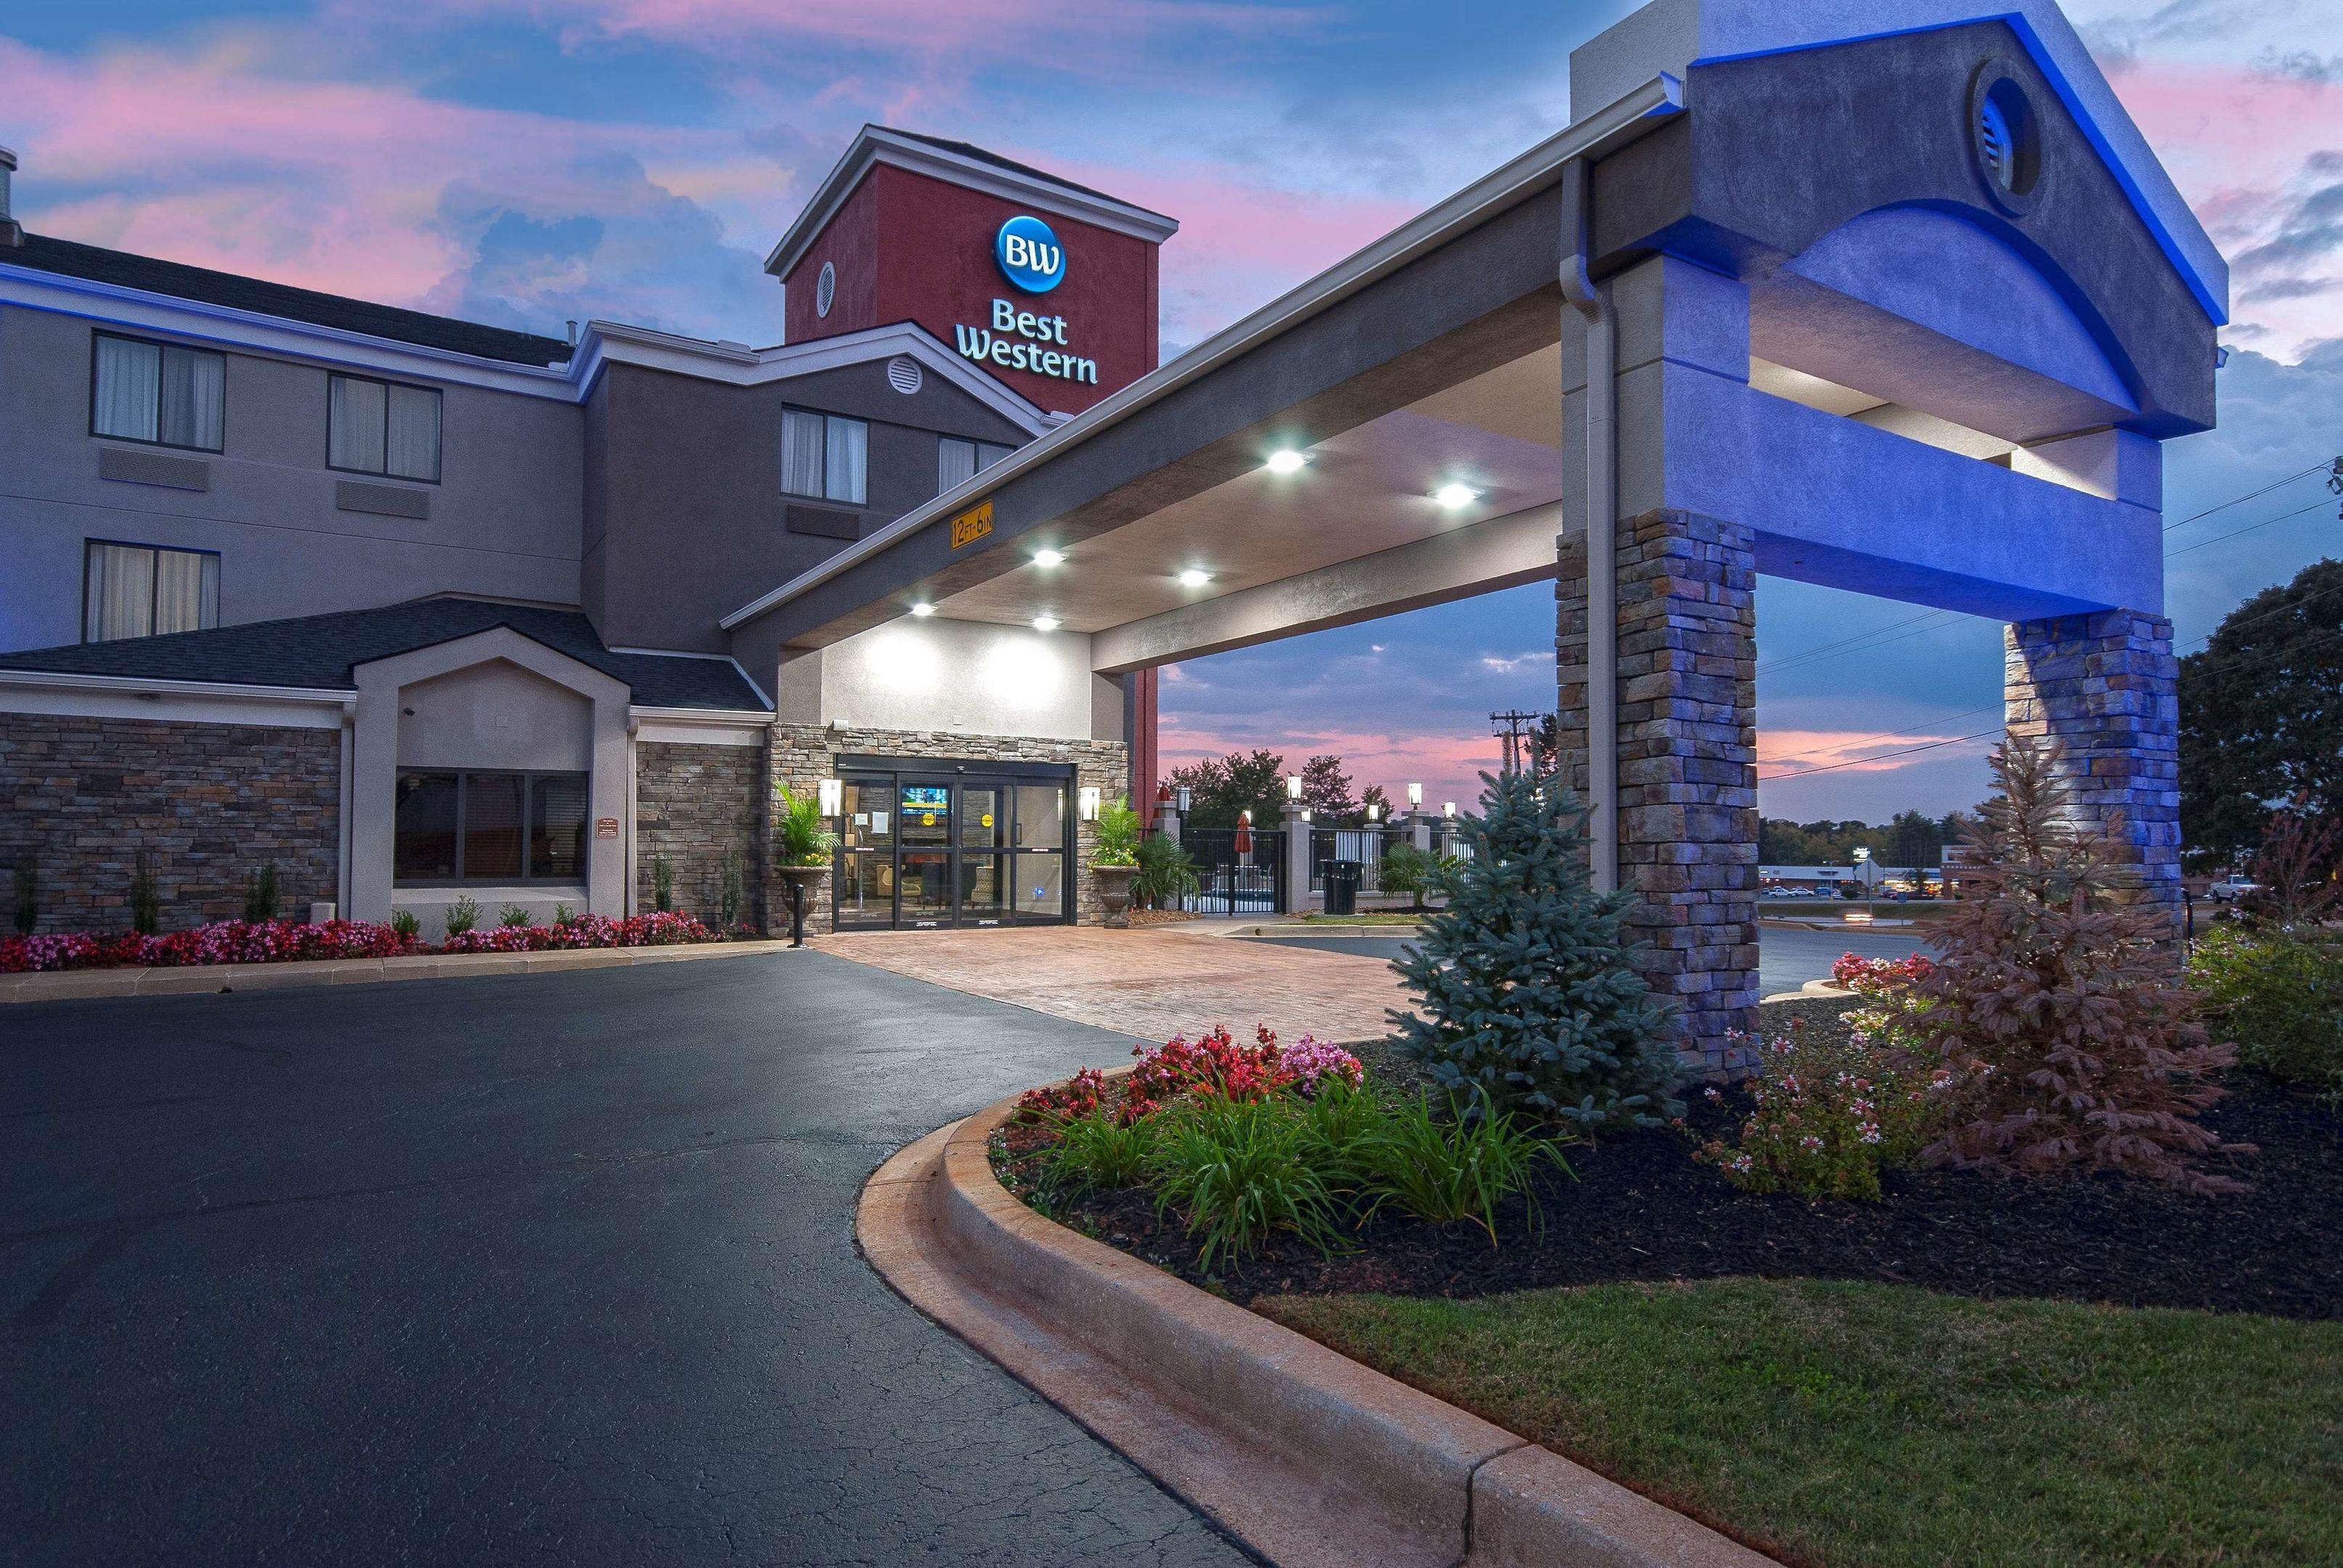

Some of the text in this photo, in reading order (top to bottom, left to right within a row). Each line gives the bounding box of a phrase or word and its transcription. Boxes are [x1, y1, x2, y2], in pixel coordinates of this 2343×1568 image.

[1006, 234, 1059, 275] BW
[992, 298, 1067, 346] Best
[955, 324, 1098, 385] Western
